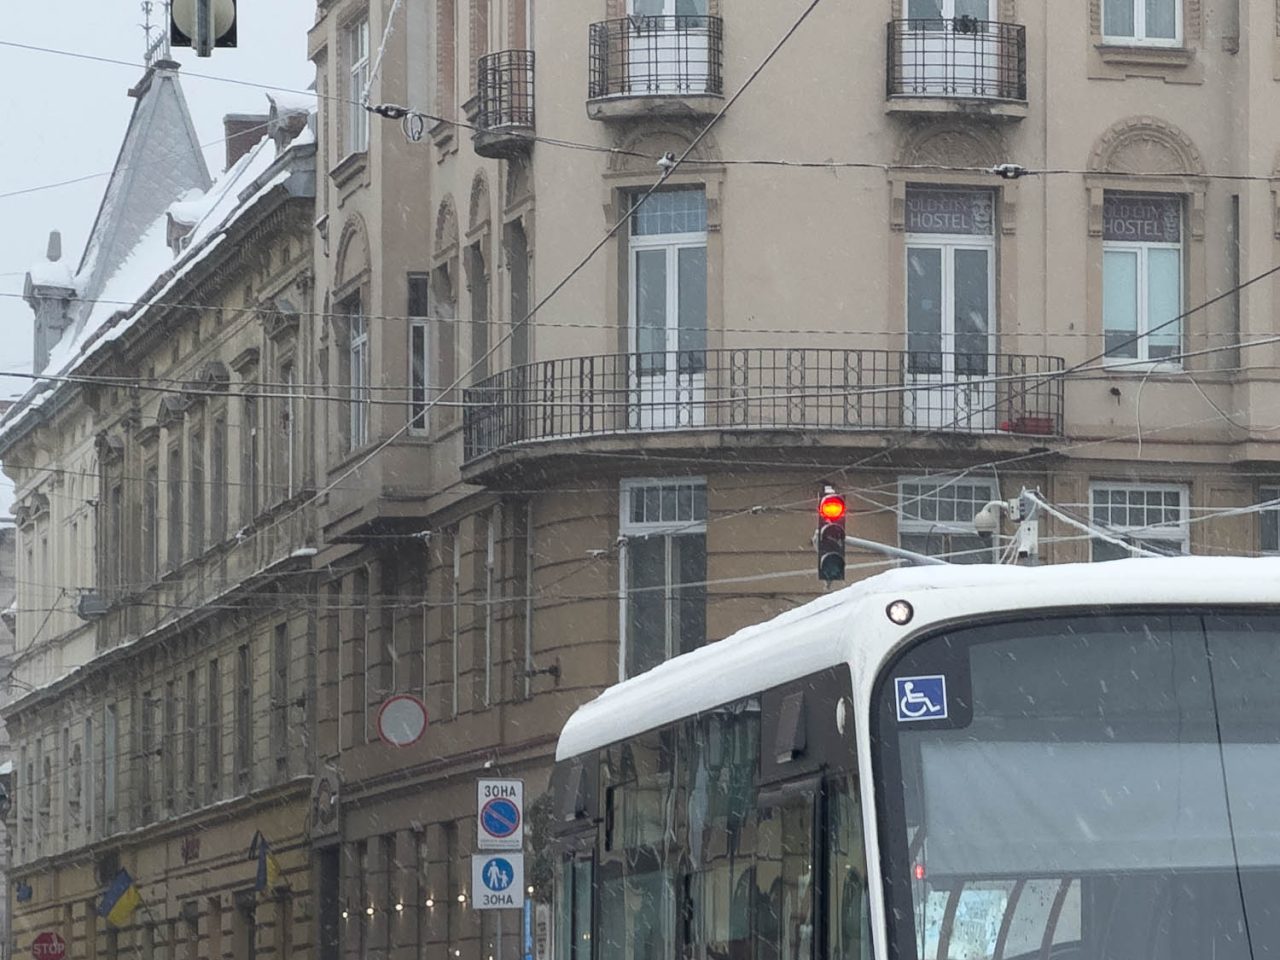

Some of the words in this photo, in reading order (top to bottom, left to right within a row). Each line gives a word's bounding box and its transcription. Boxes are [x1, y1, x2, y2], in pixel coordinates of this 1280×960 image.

[1104, 204, 1129, 218] OLD
[1133, 205, 1160, 219] CITY
[910, 212, 969, 229] HOSTEL
[1103, 218, 1162, 236] HOSTEL
[484, 784, 516, 797] ЗОНА
[483, 894, 514, 905] ЗОНА
[33, 943, 65, 955] STOP
